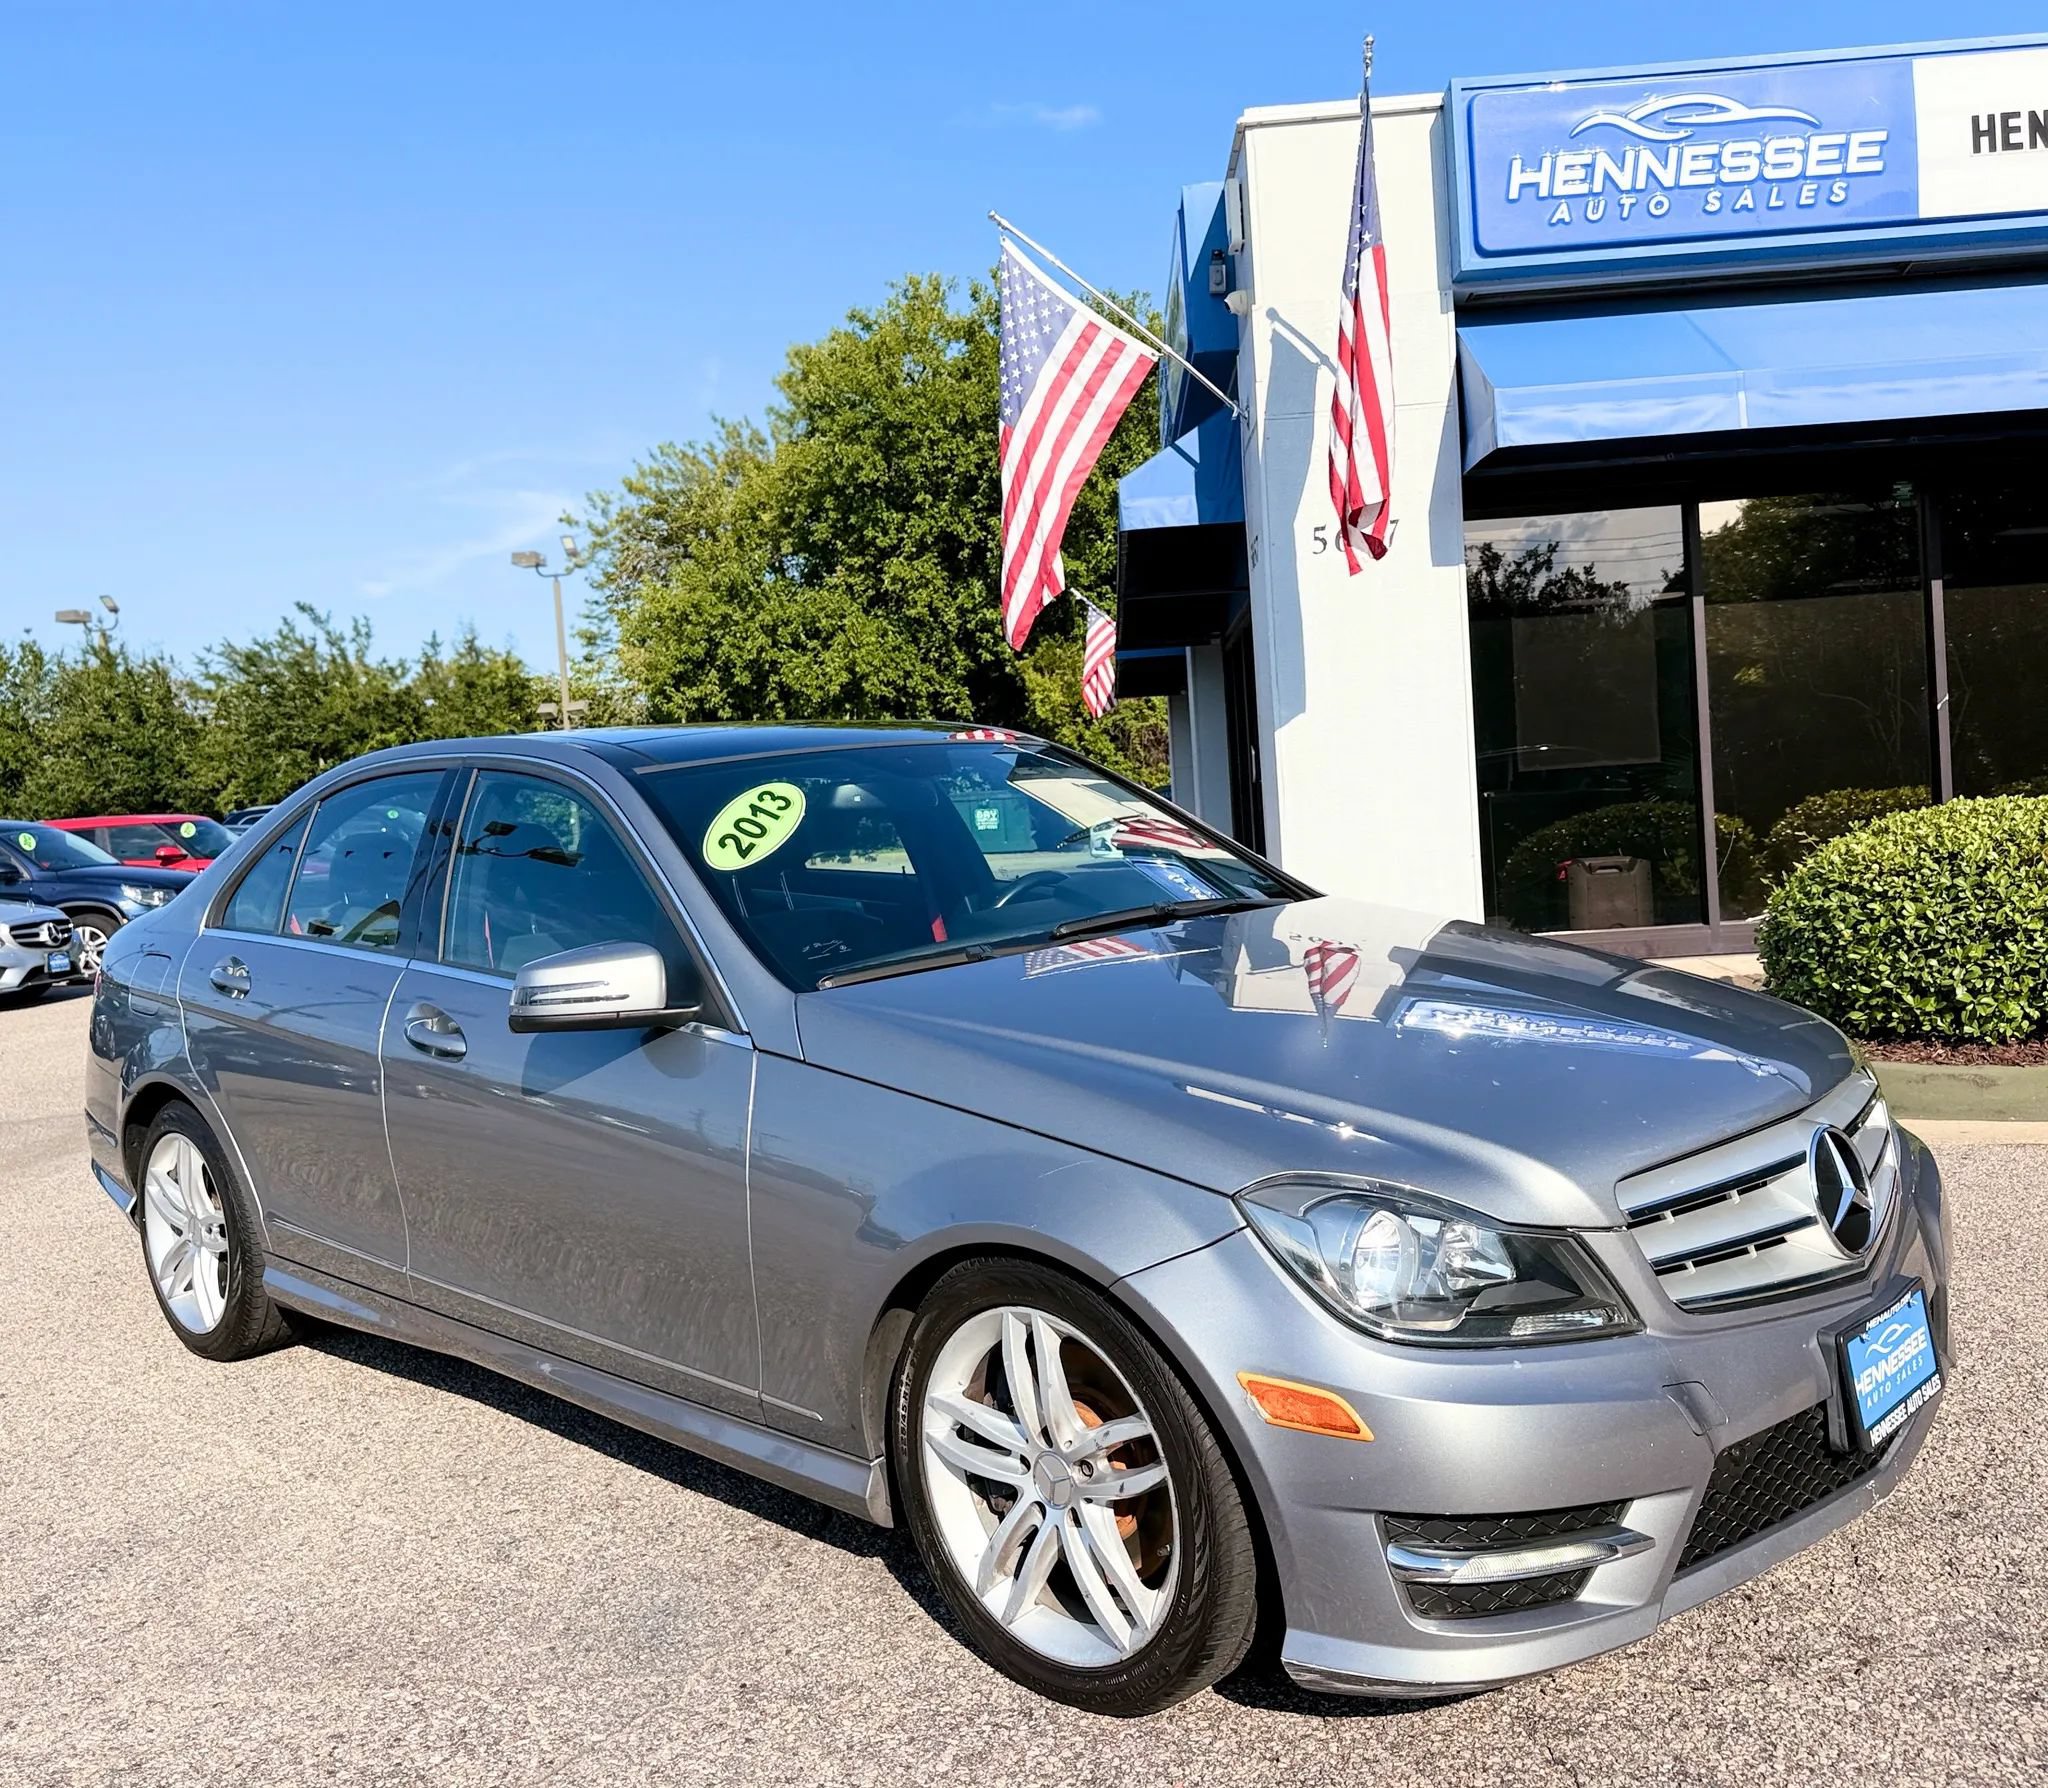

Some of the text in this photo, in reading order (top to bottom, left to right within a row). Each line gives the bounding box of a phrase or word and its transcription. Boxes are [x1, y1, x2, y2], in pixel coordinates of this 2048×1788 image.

[1507, 130, 1889, 201] HENNESSEE
[1971, 109, 2048, 155] HEN
[1549, 179, 1849, 225] AUTO SALES
[718, 790, 792, 860] 2013
[1855, 1326, 1928, 1397] HENNESSEE
[1866, 1355, 1924, 1409] AUTO SALES
[1869, 1373, 1942, 1448] HENNESSEE AUTO SALES
